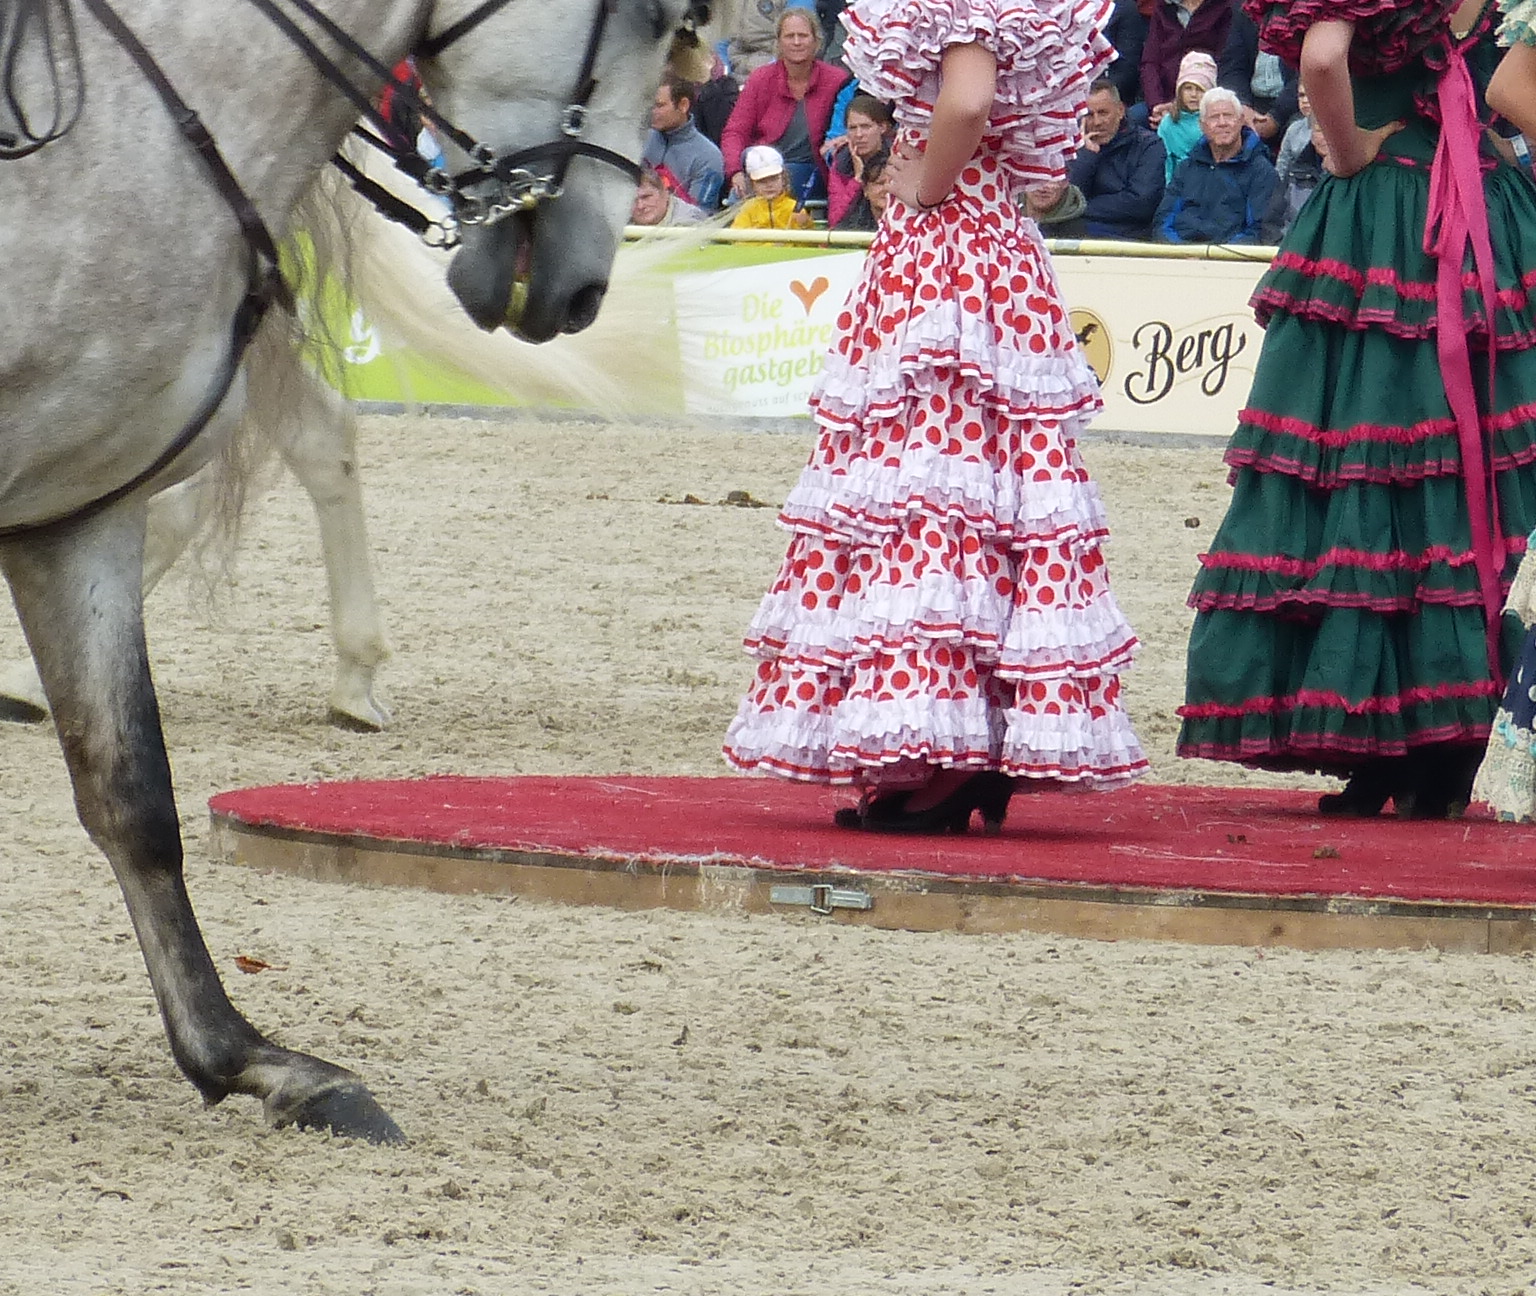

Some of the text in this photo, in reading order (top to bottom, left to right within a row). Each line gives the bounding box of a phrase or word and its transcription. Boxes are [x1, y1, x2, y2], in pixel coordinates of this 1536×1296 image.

[741, 292, 783, 323] Die
[703, 319, 834, 361] Biosphäre
[1124, 320, 1246, 404] Berg
